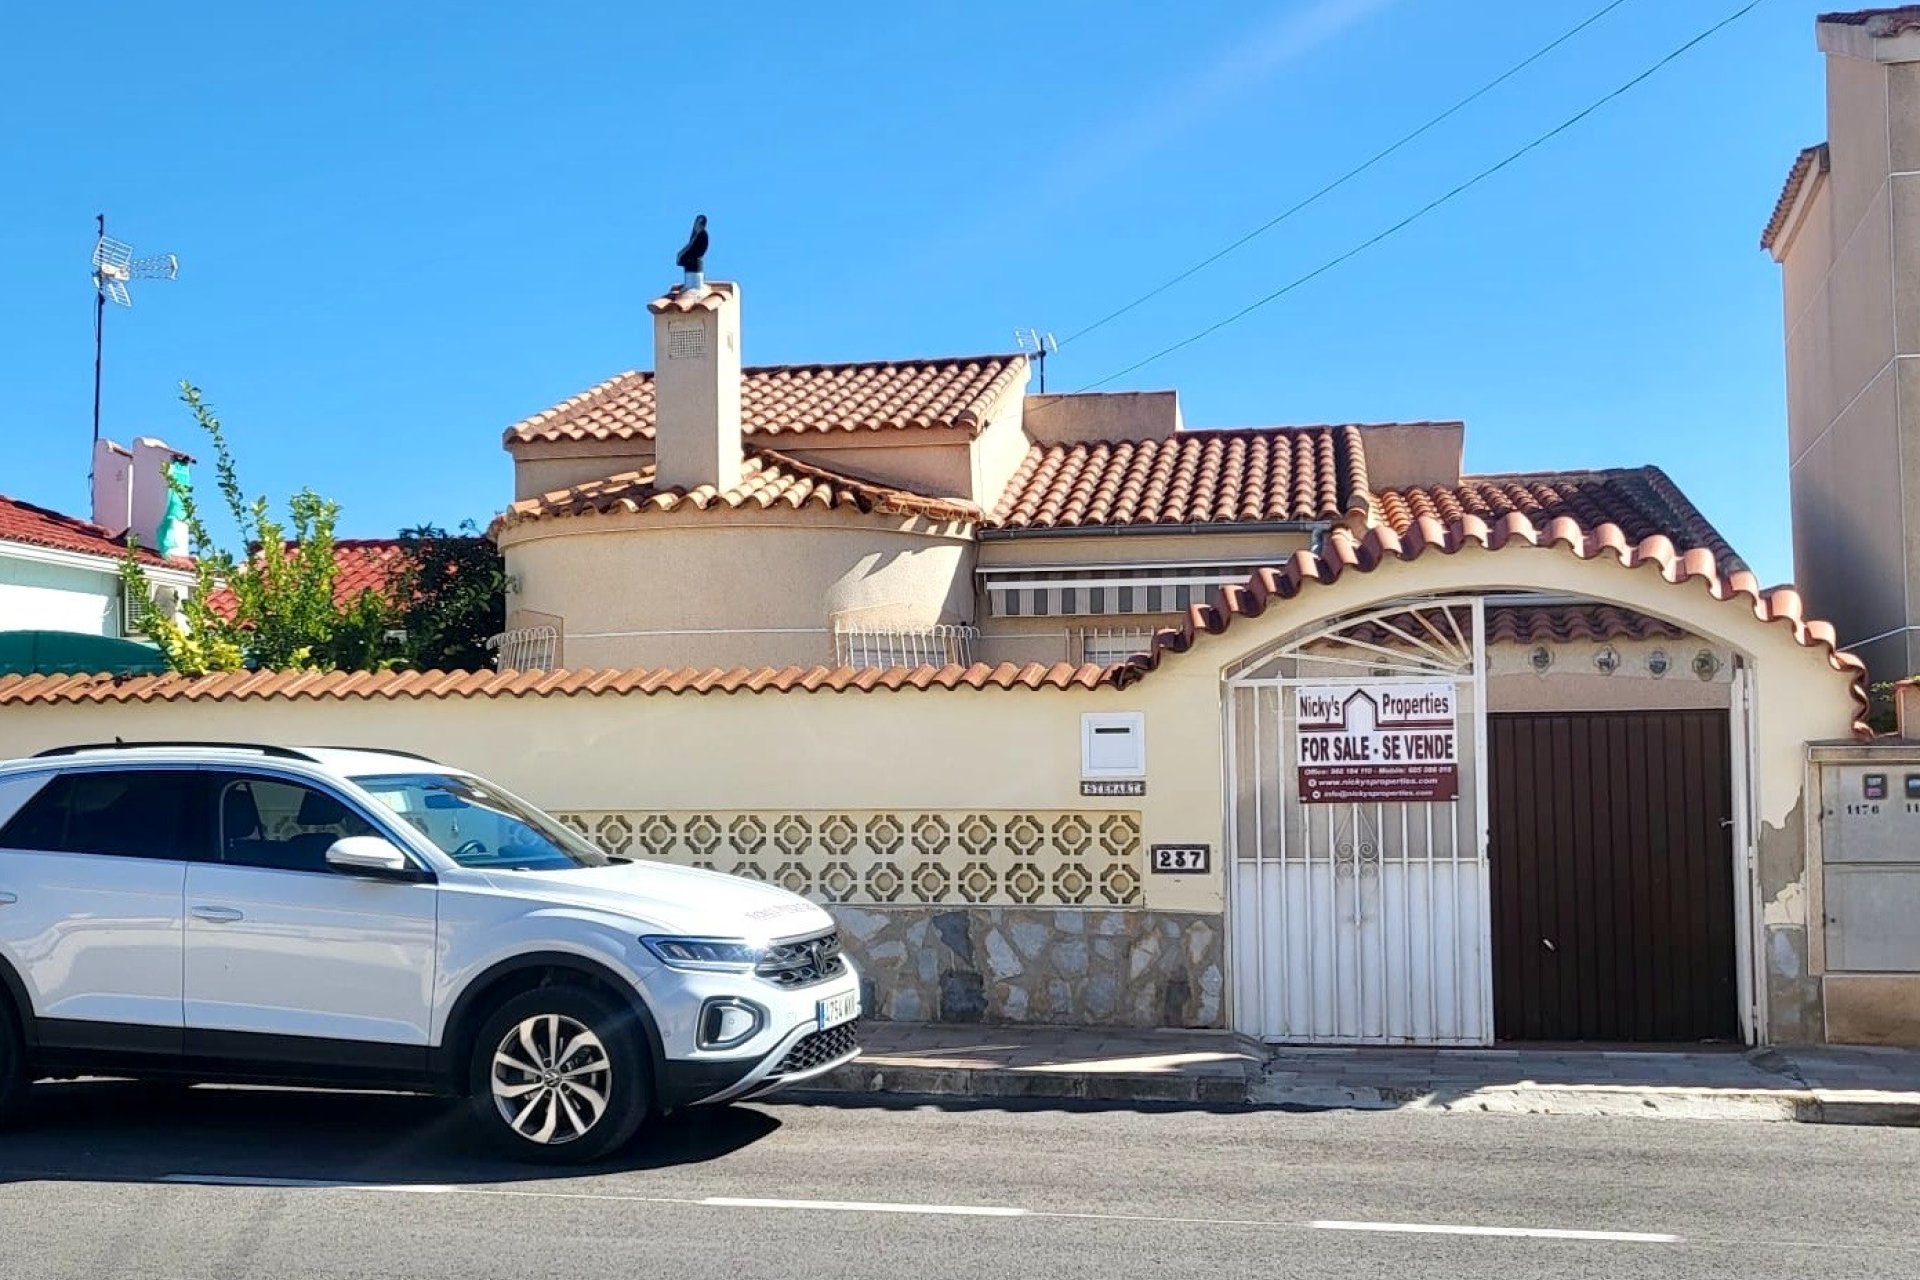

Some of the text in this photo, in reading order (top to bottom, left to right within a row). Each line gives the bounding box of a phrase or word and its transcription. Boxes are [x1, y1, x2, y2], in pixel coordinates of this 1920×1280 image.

[1300, 692, 1449, 722] Nicky's Properties
[1301, 734, 1453, 762] FOR SALE SE VENDE
[1317, 777, 1438, 788] www.nickysproperties.com
[1160, 851, 1201, 867] 237
